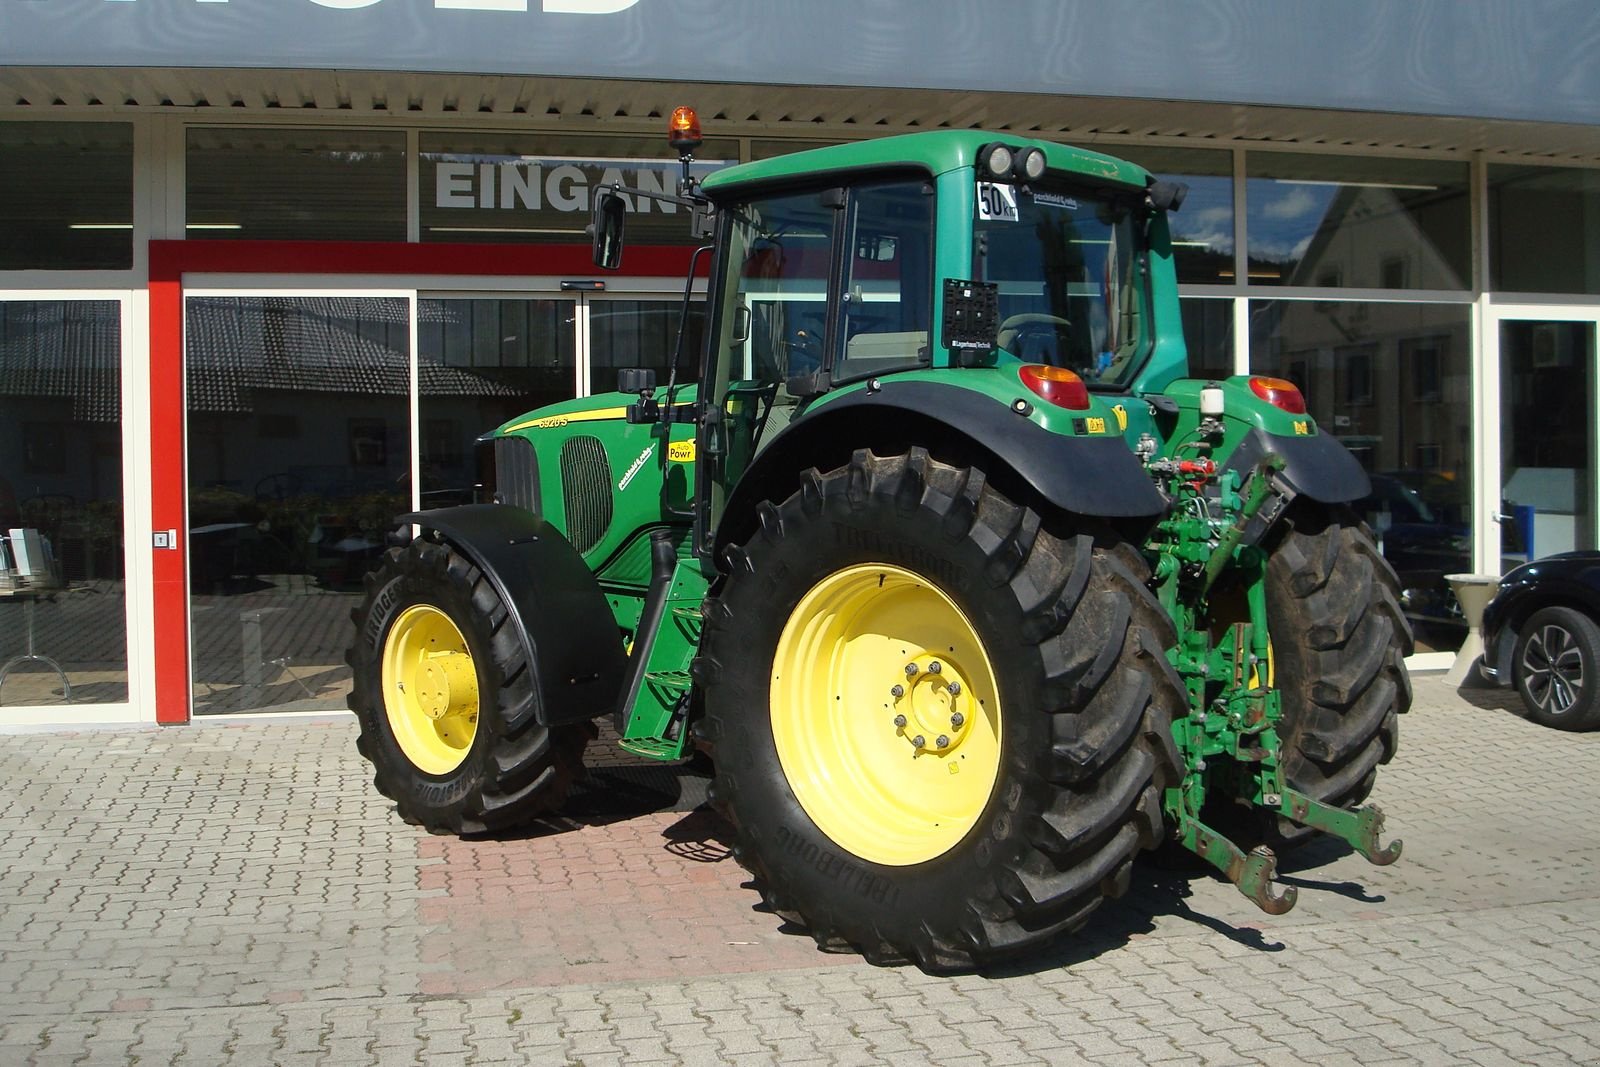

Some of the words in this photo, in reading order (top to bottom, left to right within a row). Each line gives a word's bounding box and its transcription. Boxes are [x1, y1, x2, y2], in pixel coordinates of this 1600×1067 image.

[435, 161, 714, 214] EINGAN
[980, 186, 1002, 216] 50
[670, 448, 691, 459] Powr
